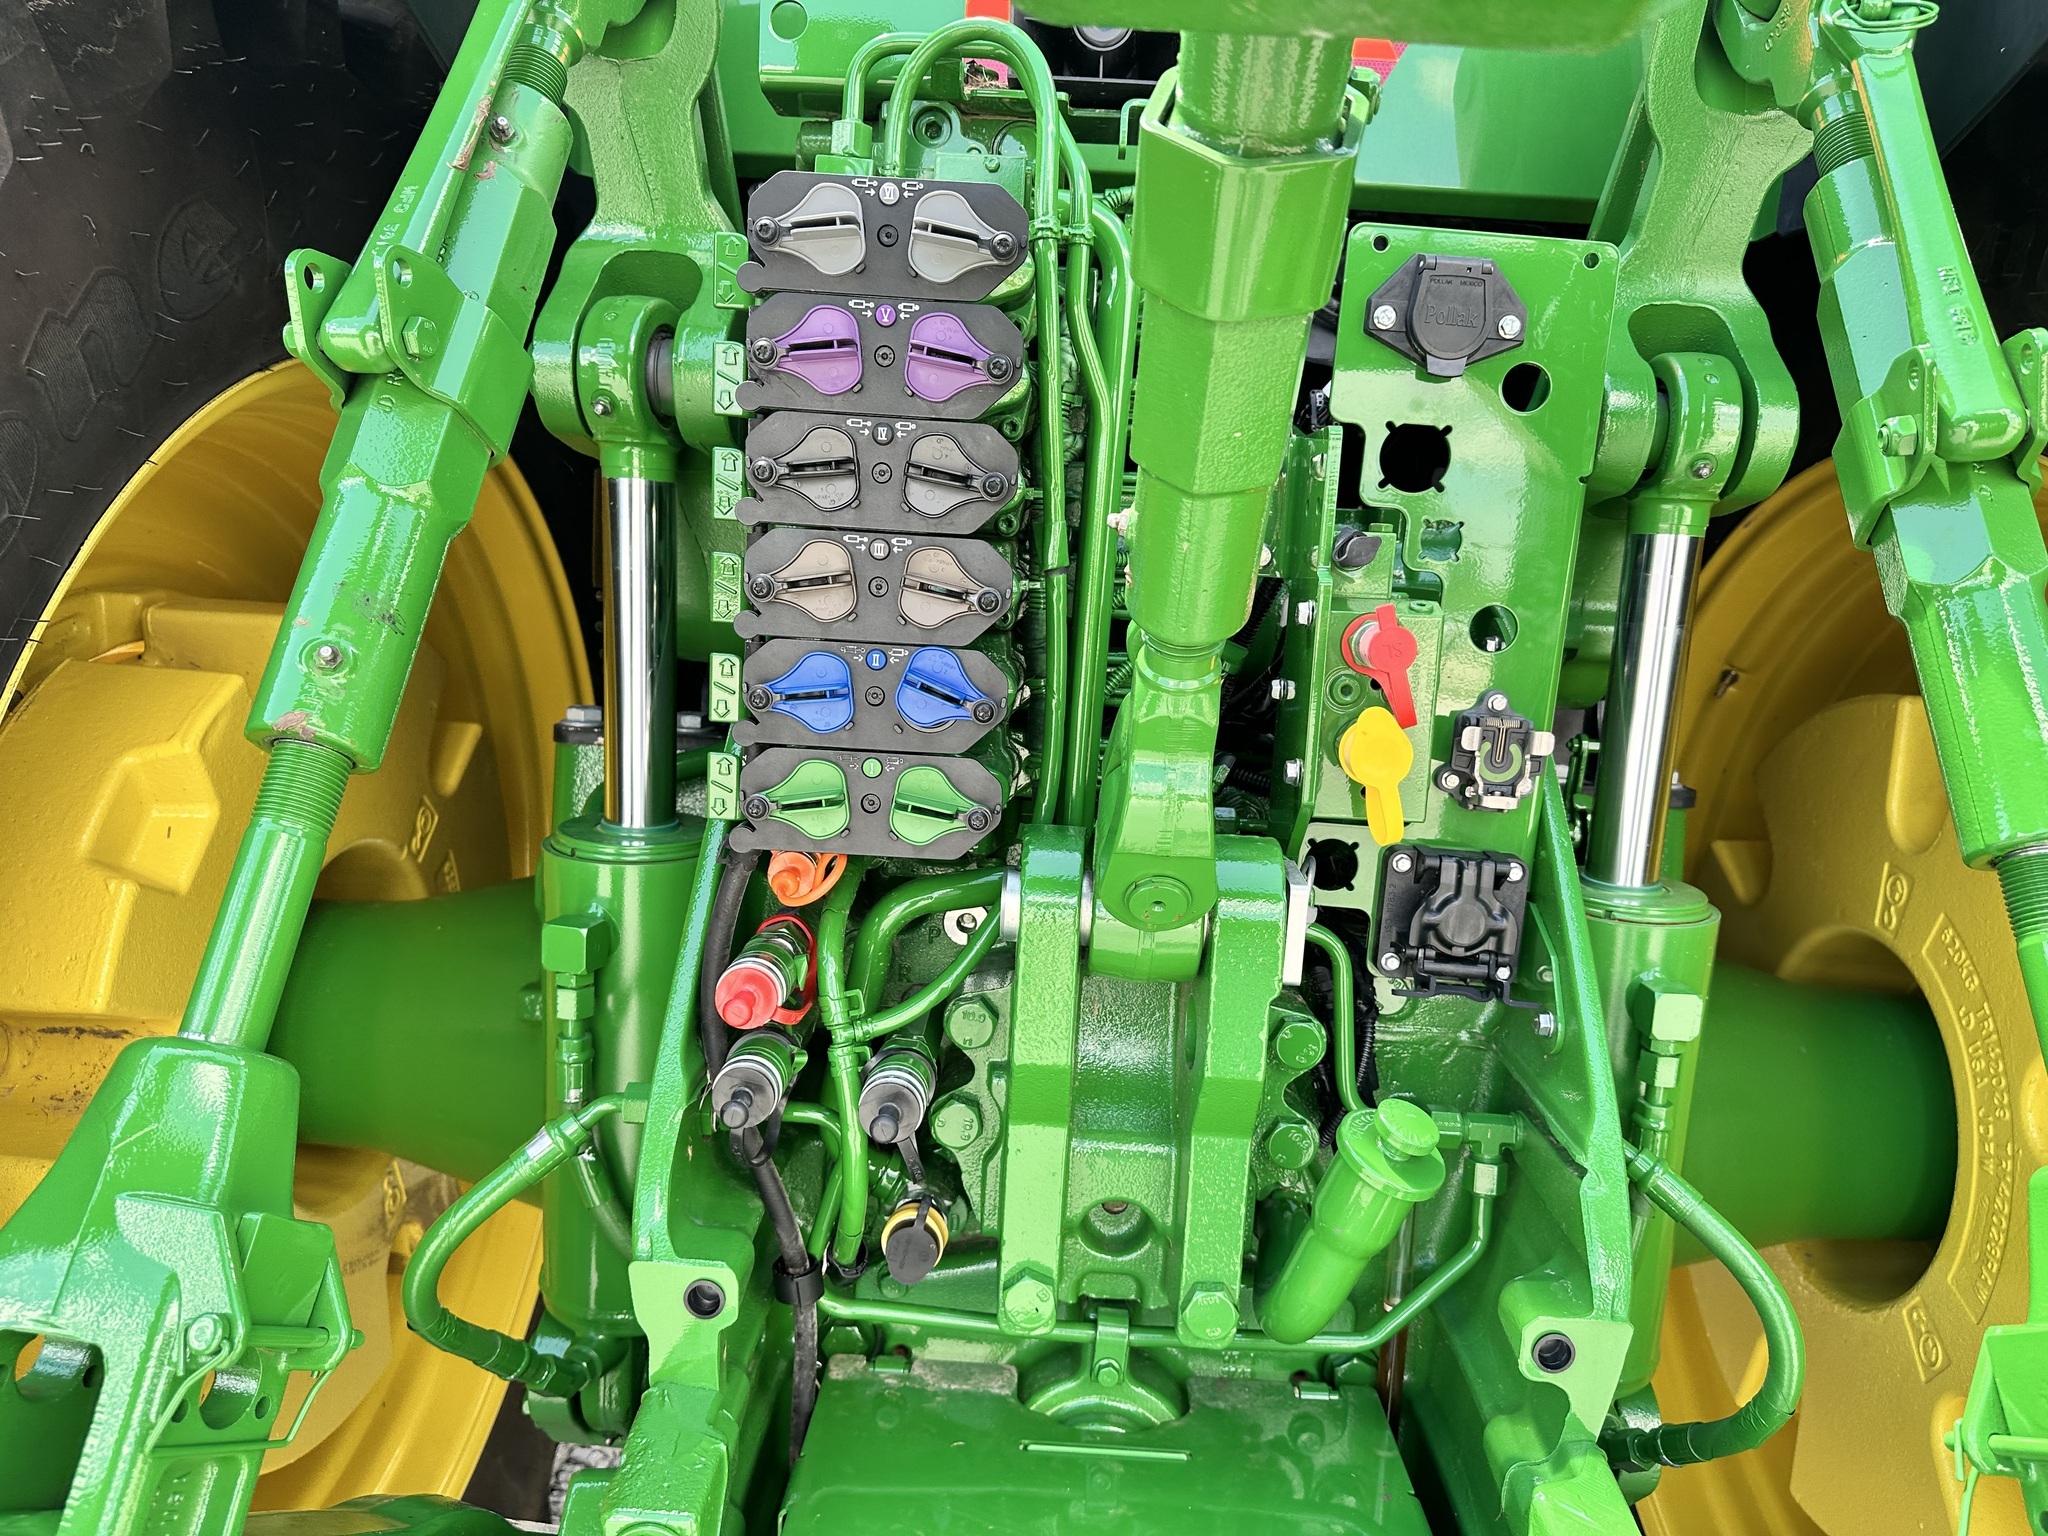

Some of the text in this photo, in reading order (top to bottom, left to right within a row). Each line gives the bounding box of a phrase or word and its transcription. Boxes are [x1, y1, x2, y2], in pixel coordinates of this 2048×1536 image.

[882, 187, 896, 201] VI
[1429, 277, 1483, 288] POLLAK MEXICO
[880, 308, 891, 323] V
[1424, 304, 1479, 328] Pollak
[877, 427, 888, 441] IV
[873, 543, 886, 557] III
[1382, 640, 1403, 659] SL
[871, 653, 882, 667] II
[1383, 918, 1392, 934] ISO
[928, 925, 942, 945] P
[961, 1008, 987, 1024] 10.9
[1967, 1041, 1987, 1090] USA
[960, 1118, 974, 1142] 10.9
